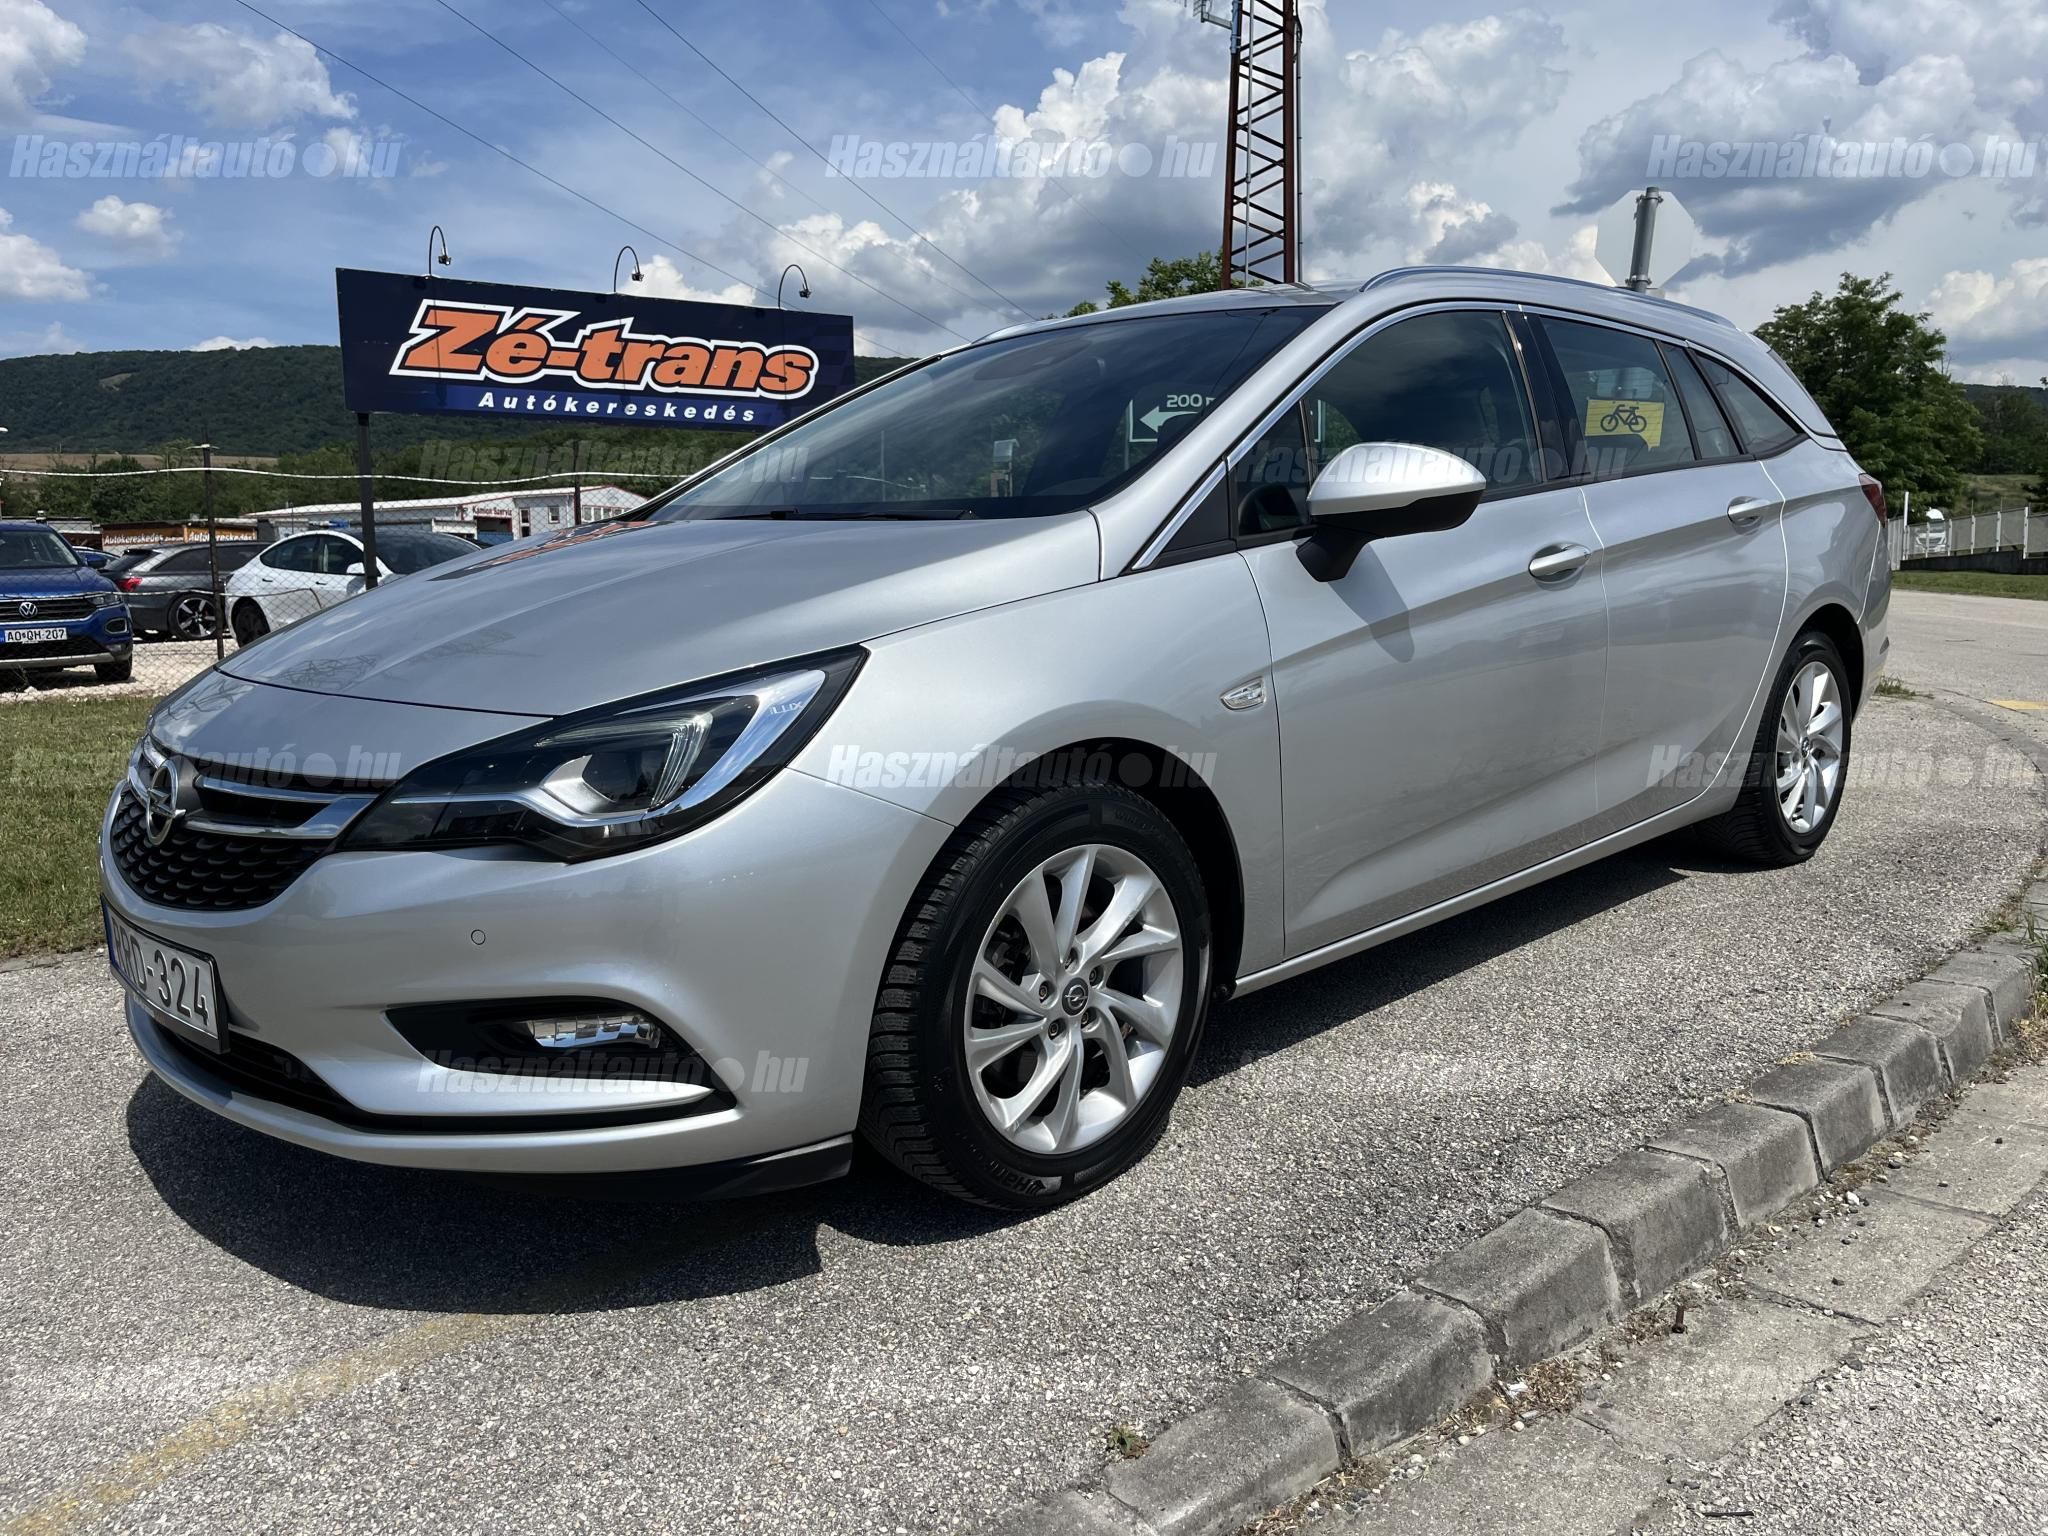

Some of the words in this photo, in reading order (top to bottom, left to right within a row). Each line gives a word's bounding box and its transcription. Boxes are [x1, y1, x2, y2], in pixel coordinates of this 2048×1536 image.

[396, 303, 821, 396] Zé-trans
[478, 391, 755, 422] Autókereskedés
[1166, 394, 1203, 408] 200
